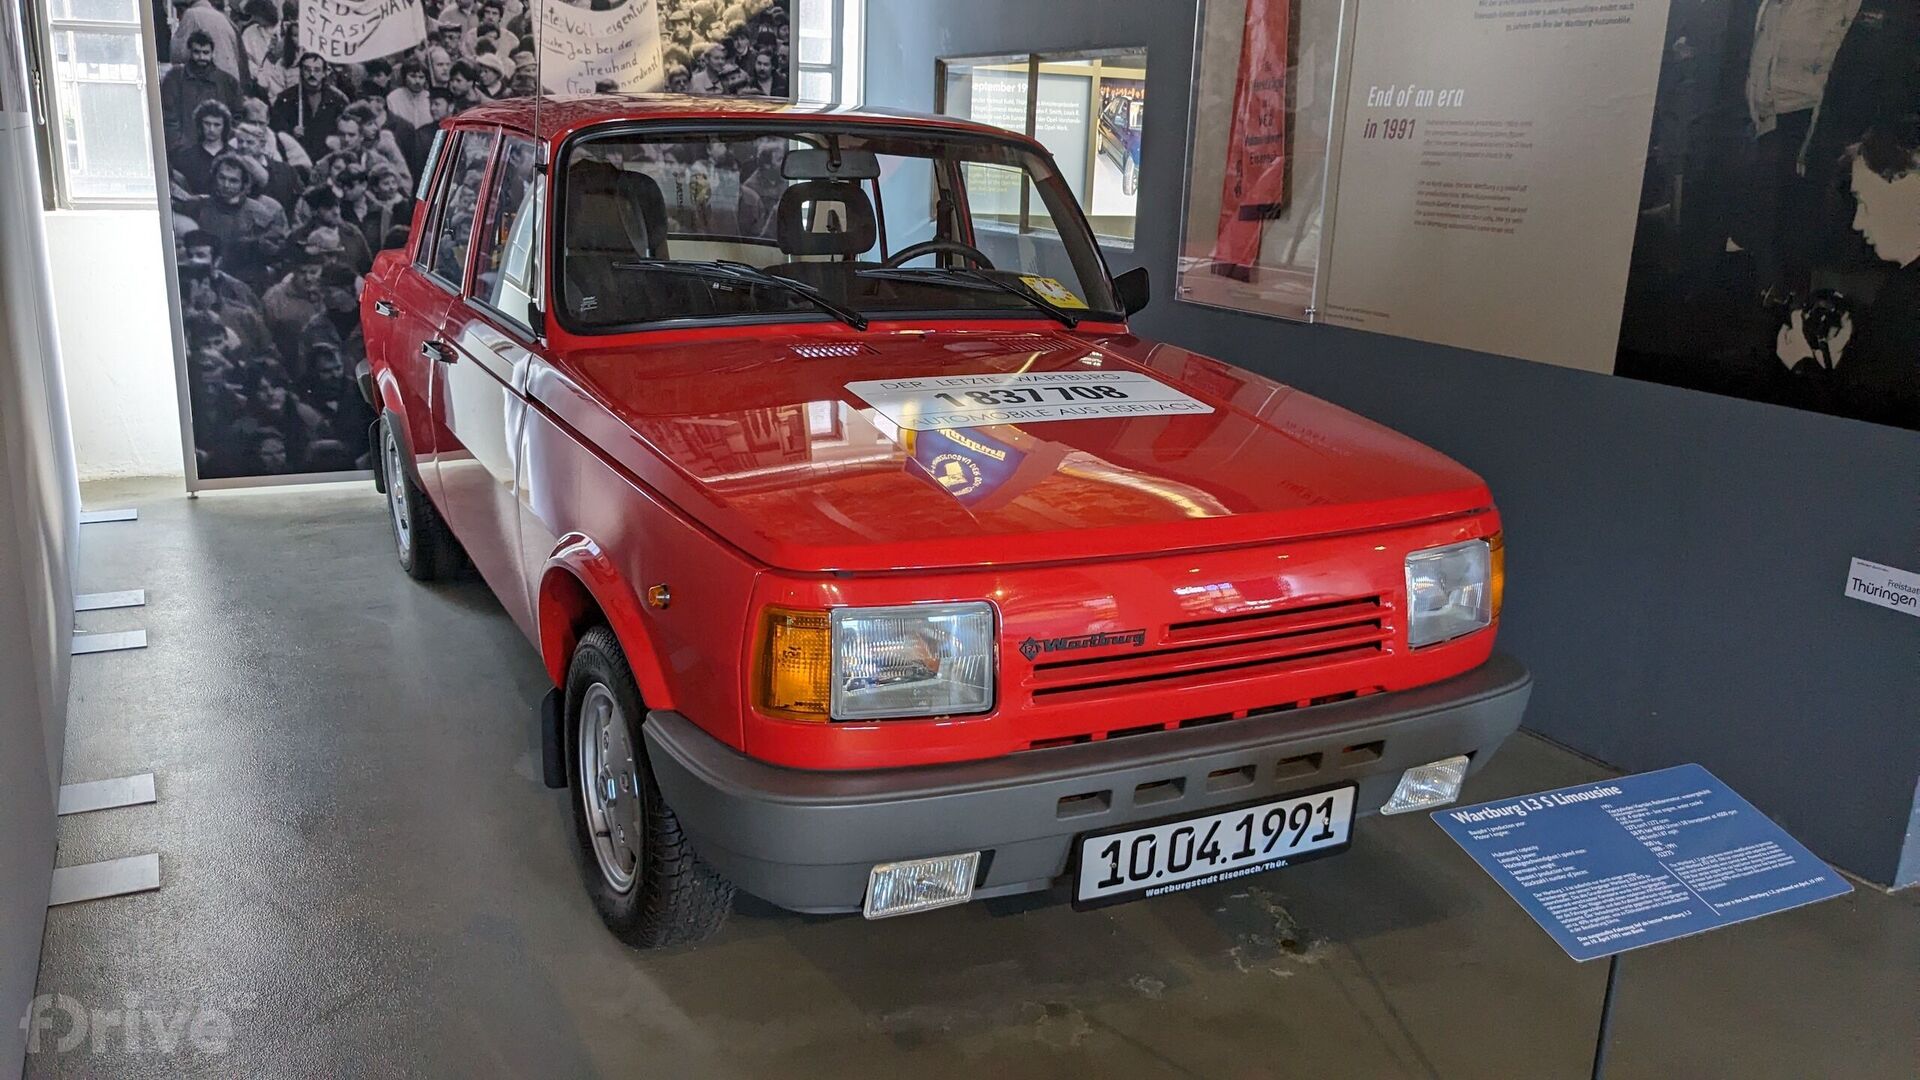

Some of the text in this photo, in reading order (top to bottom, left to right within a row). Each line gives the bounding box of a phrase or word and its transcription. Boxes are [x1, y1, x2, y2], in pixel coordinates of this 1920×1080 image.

[306, 6, 366, 38] STASI
[307, 27, 357, 57] TREU
[596, 42, 613, 54] bei
[972, 81, 1015, 93] eptember
[1367, 84, 1465, 107] End of an era
[1363, 118, 1416, 140] in 1991
[880, 373, 1121, 390] DER LETZTE WARTBURG
[934, 385, 1129, 407] 1 837 708
[912, 403, 1203, 426] AUTOMOBILE AUS EISENACH
[1852, 577, 1917, 607] Thüringen
[1043, 629, 1146, 653] Wartburg
[1450, 805, 1527, 824] Wartburg
[1540, 796, 1554, 807] S
[1550, 786, 1622, 805] Limousine
[1097, 796, 1335, 889] 10.04.1991
[1145, 874, 1218, 898] Wartburgstadt
